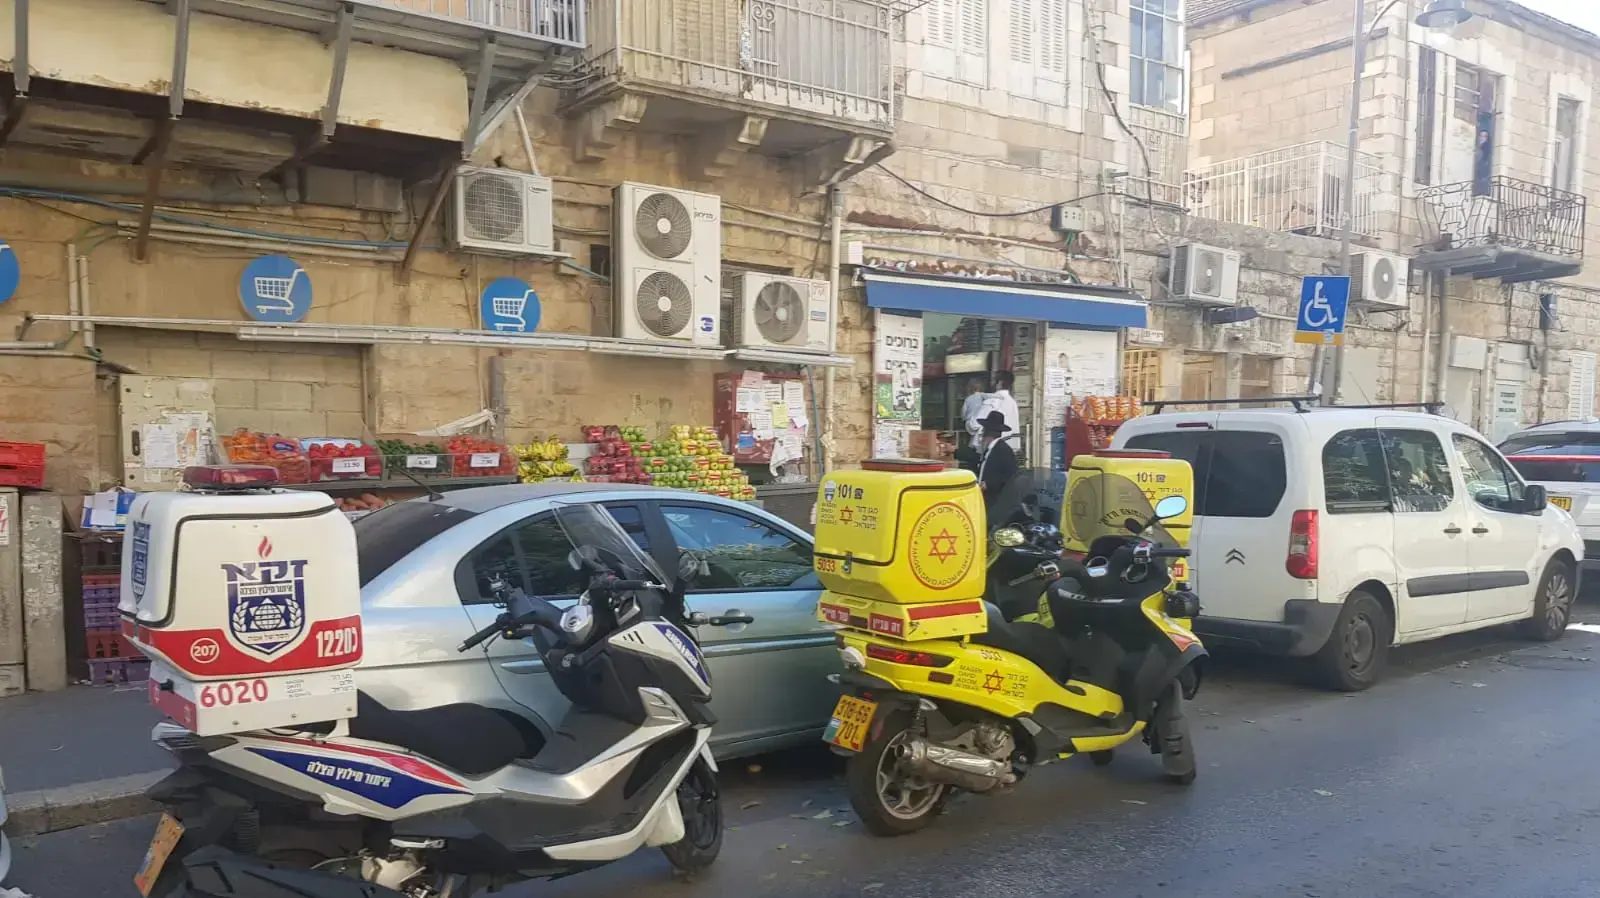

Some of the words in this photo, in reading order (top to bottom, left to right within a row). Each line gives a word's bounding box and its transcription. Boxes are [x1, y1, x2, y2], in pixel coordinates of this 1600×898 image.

[885, 335, 919, 349] ברוכים
[1136, 472, 1153, 483] 101
[838, 484, 853, 499] 101
[856, 505, 867, 513] דוד
[868, 506, 879, 514] מגן
[220, 560, 308, 583] זקא
[816, 558, 836, 572] 5033
[192, 644, 217, 657] 207
[316, 628, 353, 658] 1220
[201, 679, 269, 708] 6020
[839, 720, 860, 743] 701
[306, 761, 336, 777] הצלה
[336, 767, 364, 783] חילוץ
[364, 773, 392, 788] איתור
